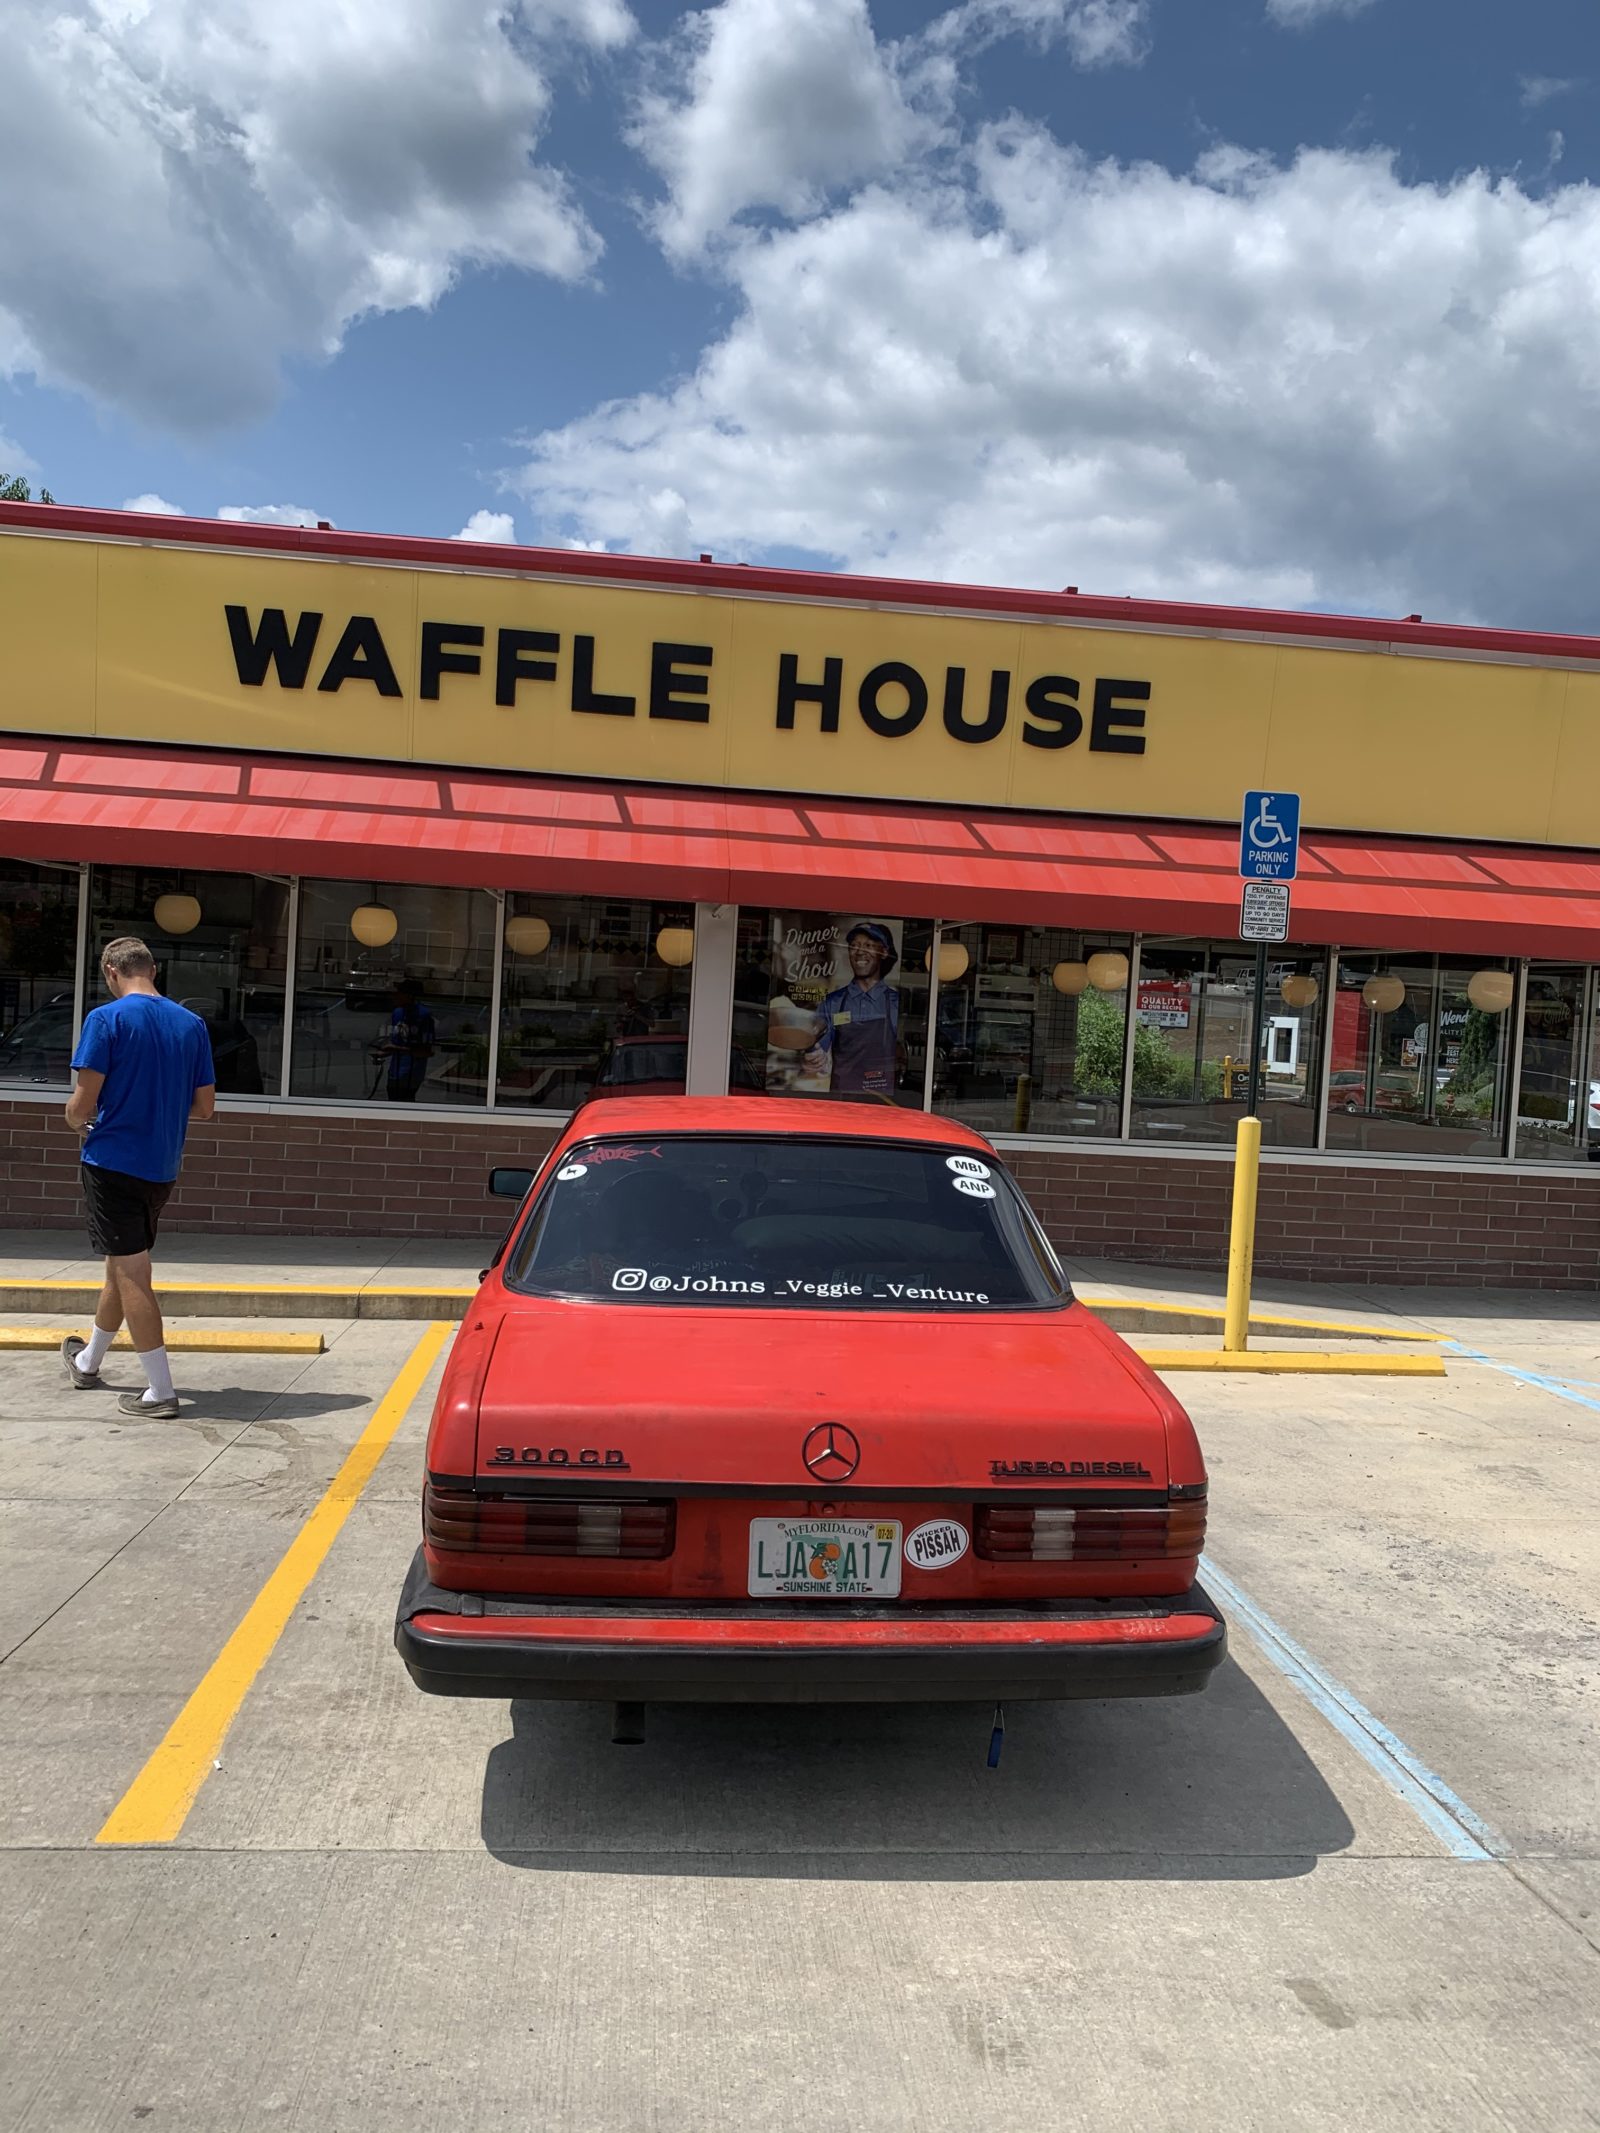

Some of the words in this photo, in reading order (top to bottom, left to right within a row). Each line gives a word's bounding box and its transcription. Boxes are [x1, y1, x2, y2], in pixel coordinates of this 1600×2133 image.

[224, 604, 714, 724] WAFFLE
[776, 653, 1152, 755] HOUSE
[1248, 850, 1289, 863] PARKING
[1255, 863, 1281, 875] ONLY
[1252, 886, 1282, 894] PENALTY
[1244, 924, 1270, 932] TOW-AWAY
[785, 926, 841, 947] Dinner
[800, 943, 817, 956] and
[818, 944, 826, 953] a
[784, 957, 839, 983] Show
[1141, 996, 1184, 1006] QUALITY
[1440, 1009, 1470, 1027] Wend
[954, 1160, 983, 1174] MBI
[960, 1180, 990, 1193] ANP
[649, 1275, 766, 1294] @Johns
[988, 1460, 1066, 1474] TURBO
[1069, 1461, 1151, 1475] DIESEL
[784, 1523, 870, 1539] MYFLORIDA.COM
[877, 1529, 894, 1540] 07-20
[916, 1526, 951, 1539] WICKED
[913, 1529, 962, 1561] PISSAH
[758, 1541, 808, 1579] LJA
[842, 1541, 893, 1579] A17
[783, 1581, 834, 1593] SUNSHINE
[836, 1582, 868, 1593] STATE
